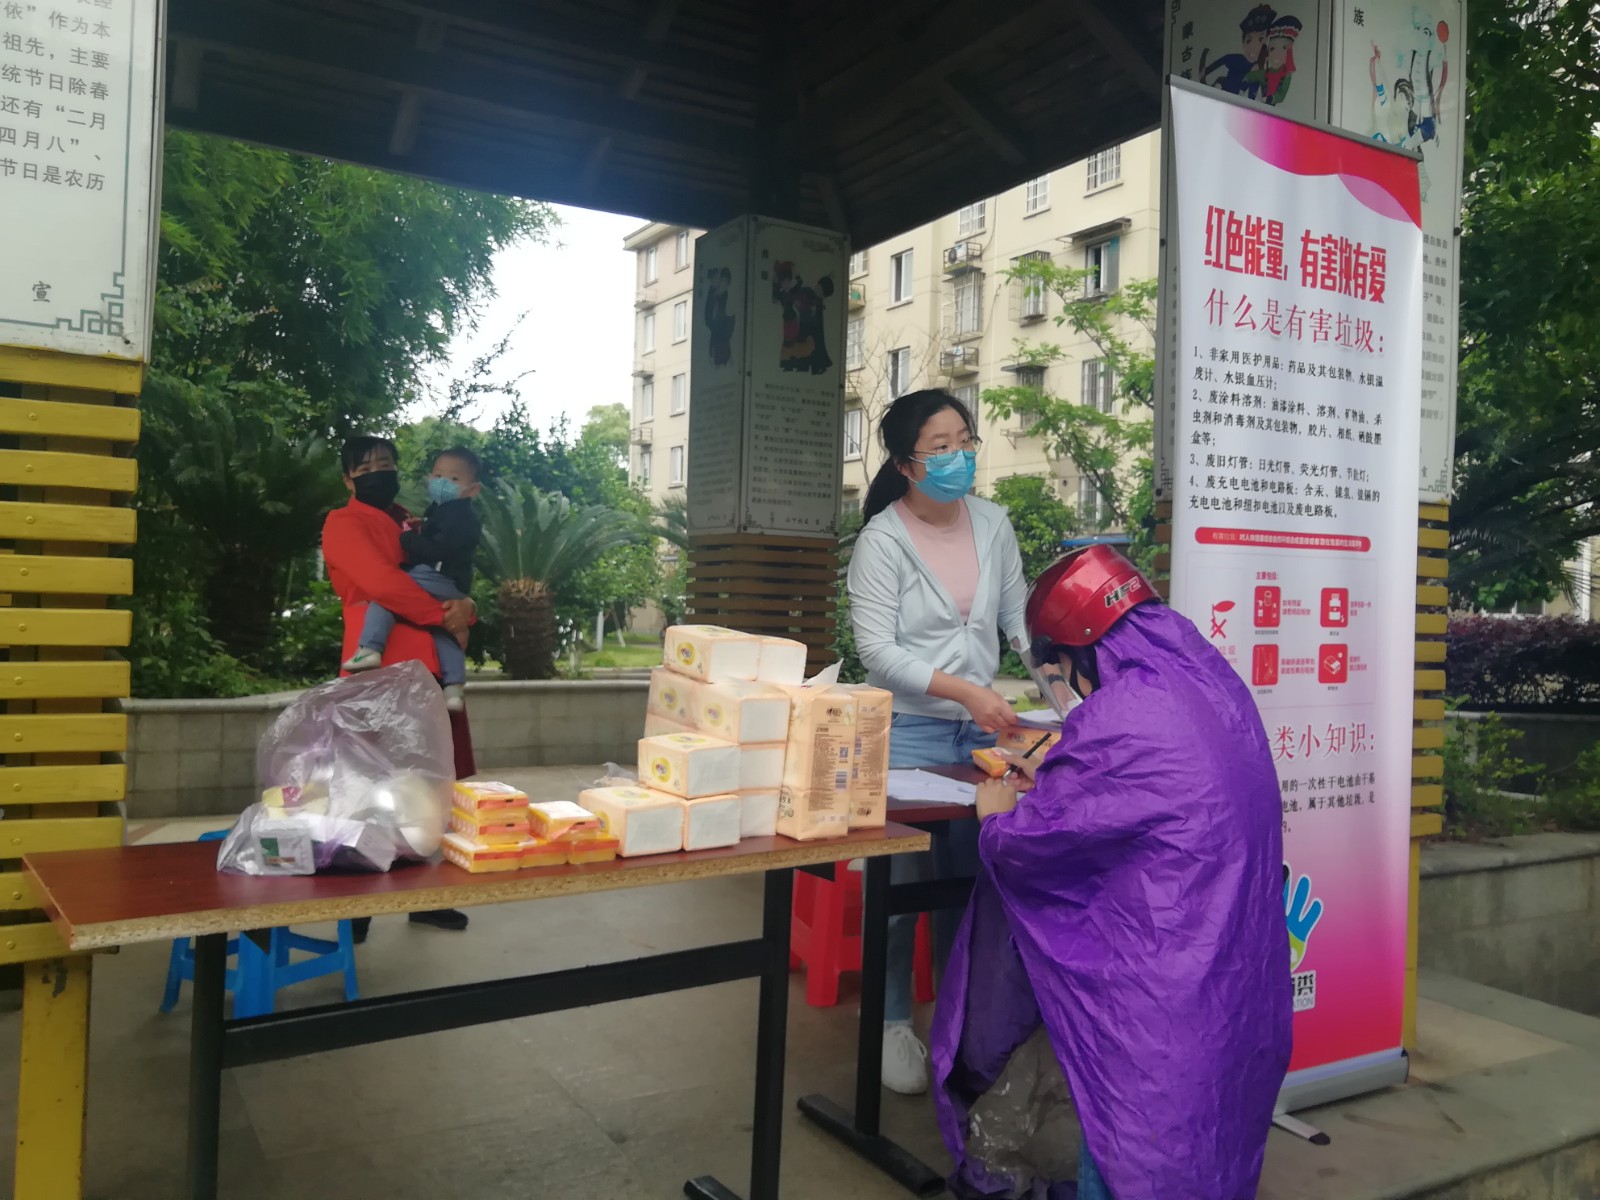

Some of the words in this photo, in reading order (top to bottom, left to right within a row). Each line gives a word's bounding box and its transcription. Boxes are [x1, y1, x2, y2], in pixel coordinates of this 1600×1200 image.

[3, 31, 110, 70] 祖先，主要
[1, 63, 109, 101] 统节日除春
[0, 95, 105, 130] 还有“二月
[0, 157, 105, 191] 节日是农历
[1203, 287, 1384, 354] 什么是有害垃圾：
[1267, 721, 1375, 761] 类小知识：
